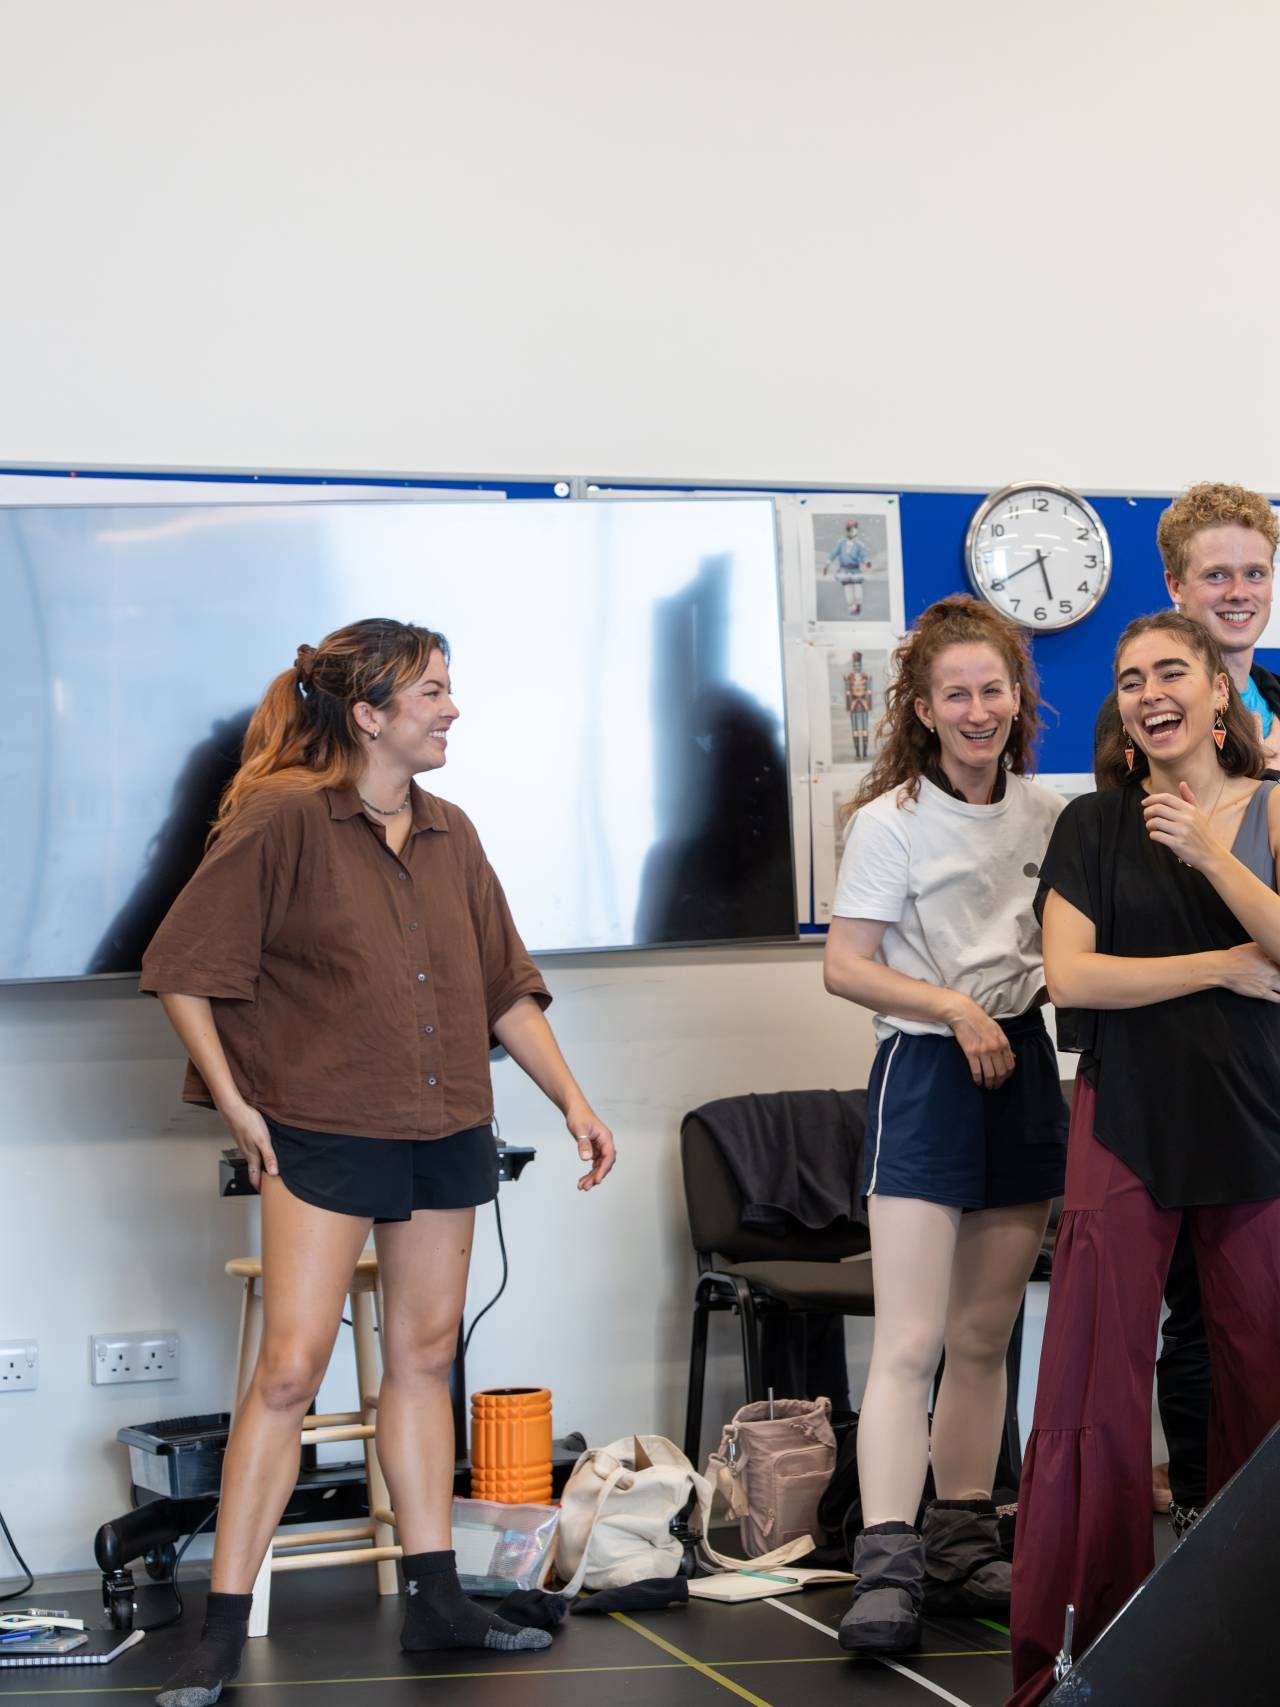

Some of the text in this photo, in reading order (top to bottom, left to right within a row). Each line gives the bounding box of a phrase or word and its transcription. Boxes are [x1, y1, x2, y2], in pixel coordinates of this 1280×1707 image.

[1032, 498, 1049, 512] 12
[1063, 505, 1068, 516] 1
[1009, 505, 1020, 520] 11
[990, 524, 1005, 537] 10
[1077, 527, 1089, 541] 2
[1084, 555, 1097, 569] 3
[990, 578, 1005, 592] 8
[1077, 580, 1090, 594] 4
[1009, 599, 1021, 612] 7
[1059, 600, 1072, 614] 5
[1034, 607, 1047, 621] 6
